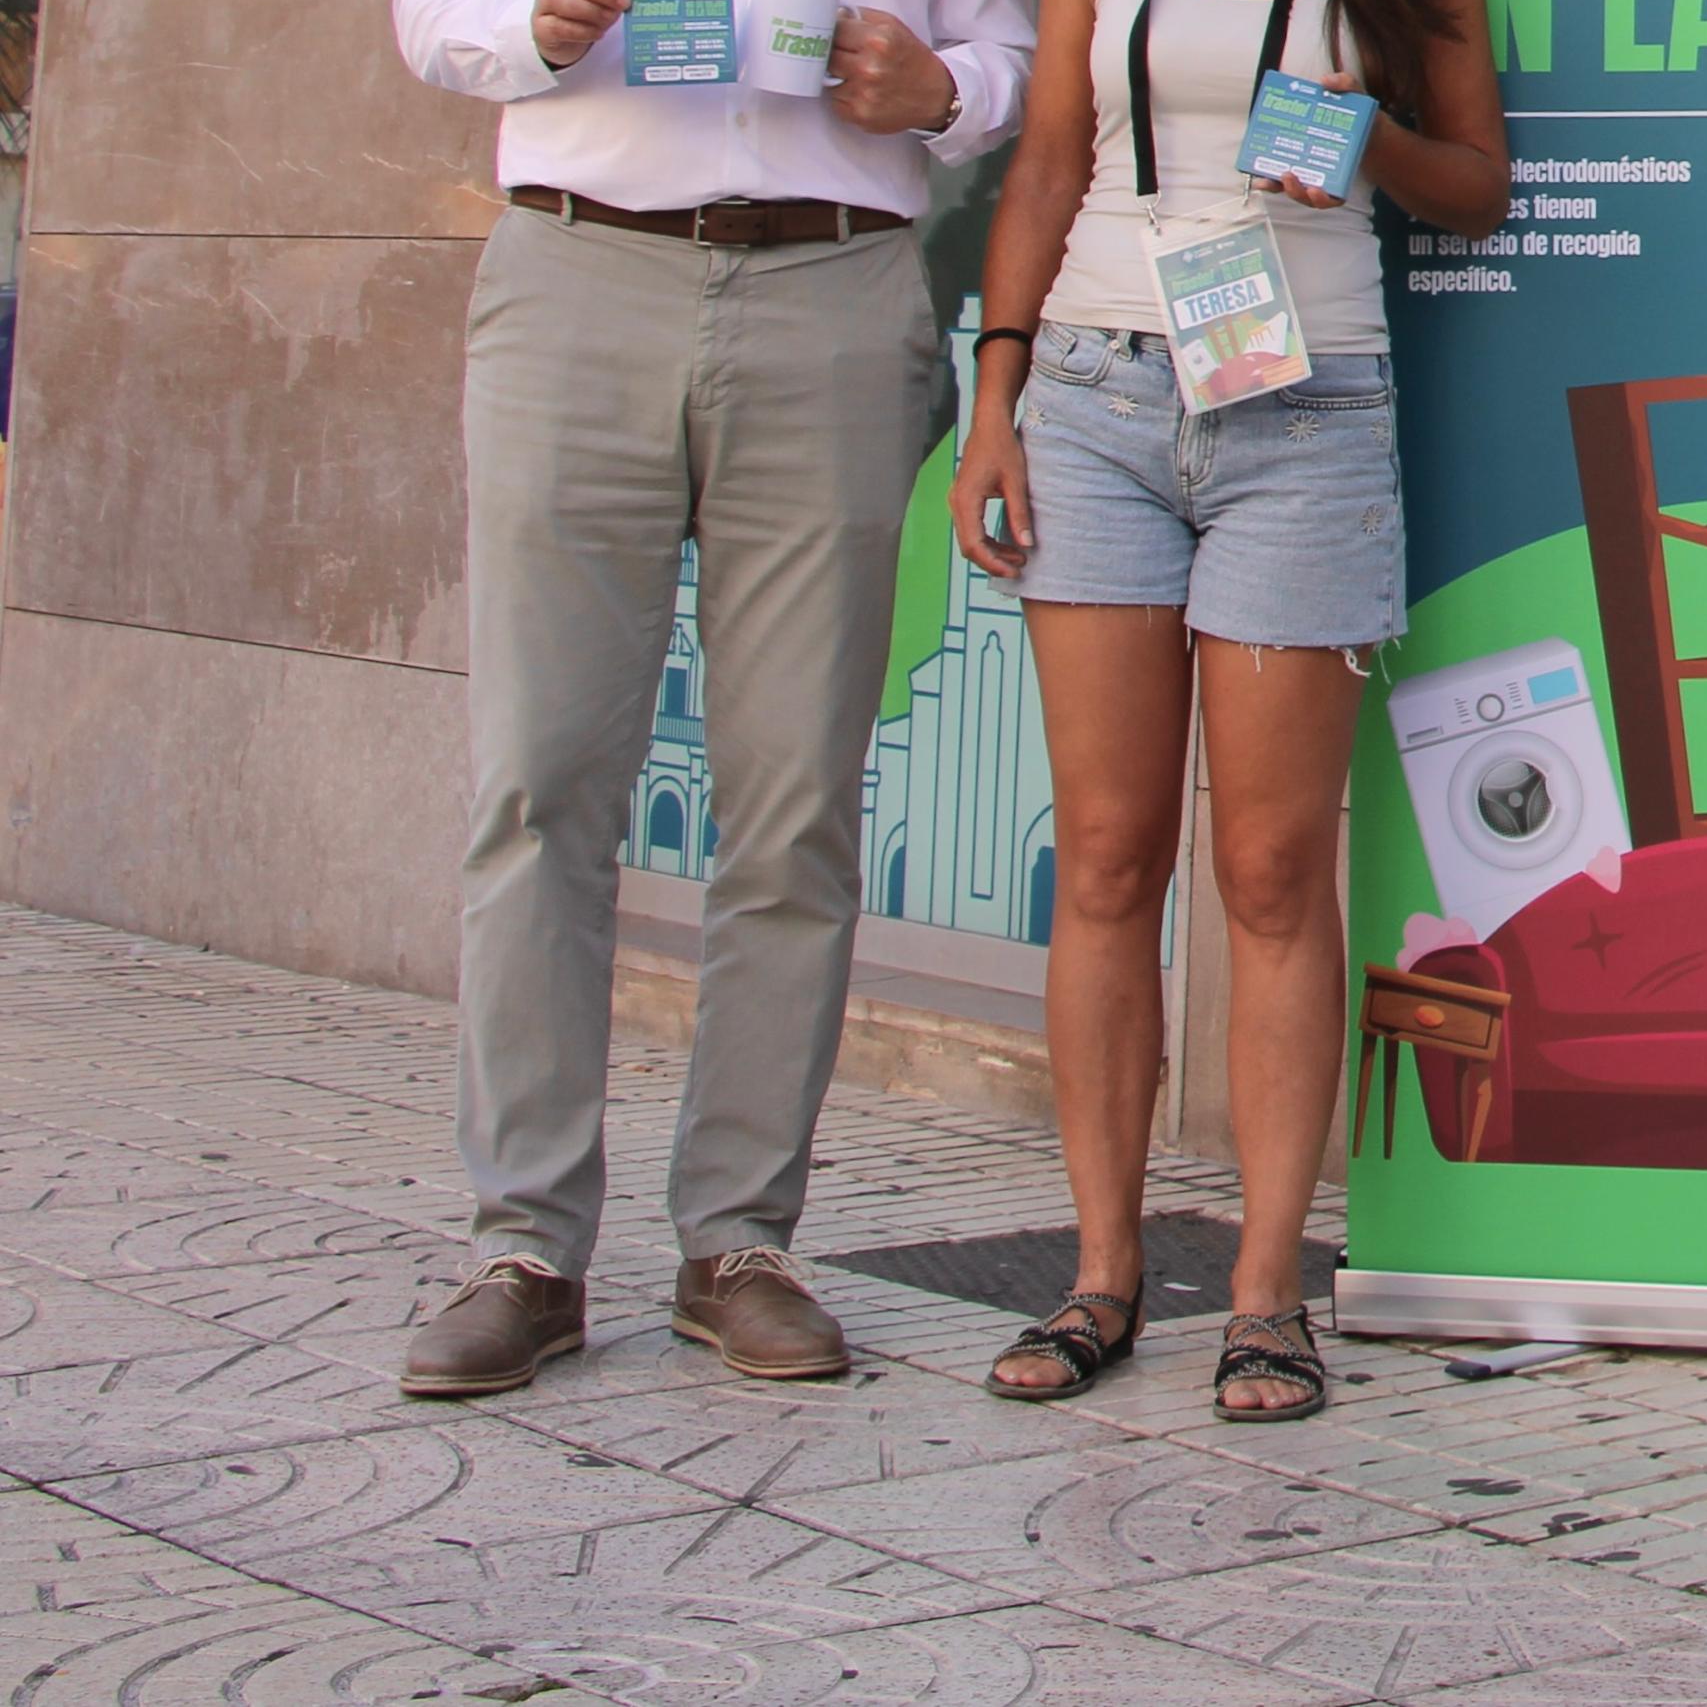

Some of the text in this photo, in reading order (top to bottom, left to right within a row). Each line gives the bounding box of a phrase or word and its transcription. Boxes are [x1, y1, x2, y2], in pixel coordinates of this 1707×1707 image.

[1533, 194, 1597, 219] tienen
[1408, 229, 1641, 258] un servicio de recogida
[1408, 267, 1517, 295] específico.
[1184, 279, 1262, 323] TERESA
